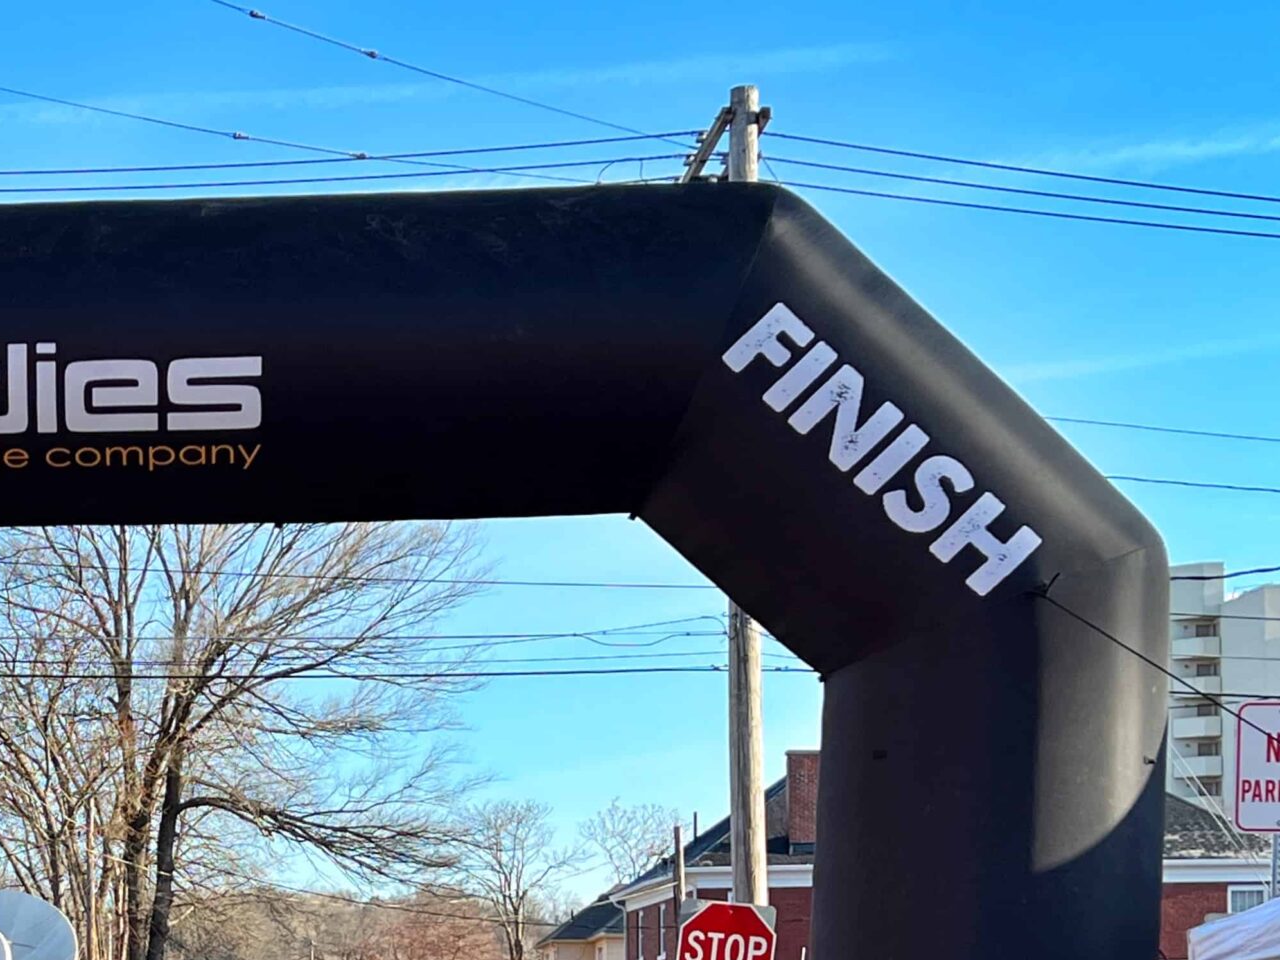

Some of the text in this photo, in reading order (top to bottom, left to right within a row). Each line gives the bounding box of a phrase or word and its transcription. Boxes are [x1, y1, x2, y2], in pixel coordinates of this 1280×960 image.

[45, 443, 261, 472] company
[722, 302, 1042, 597] FINISH
[1240, 779, 1280, 803] PAR
